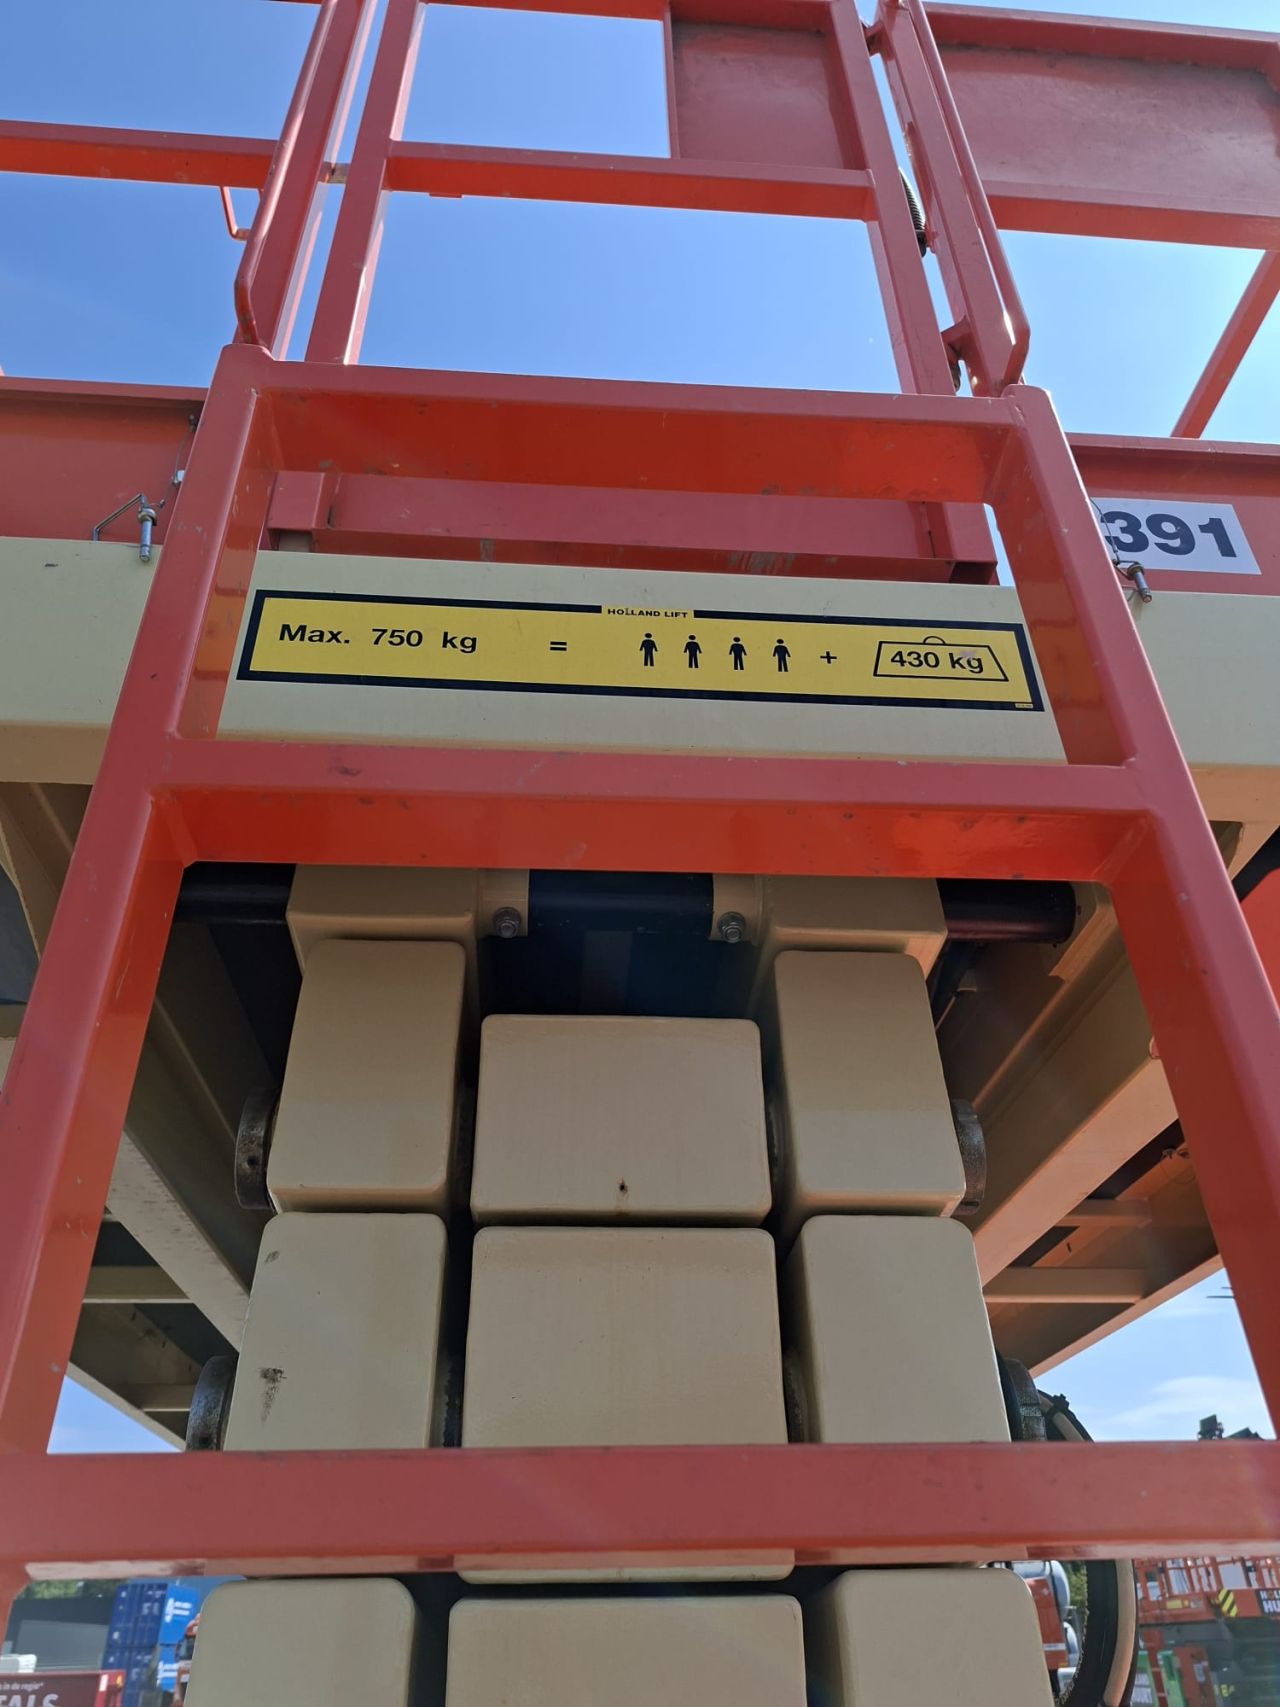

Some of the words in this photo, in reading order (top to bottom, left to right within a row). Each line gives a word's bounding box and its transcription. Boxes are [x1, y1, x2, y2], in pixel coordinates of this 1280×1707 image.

[1100, 510, 1237, 558] 391
[607, 608, 661, 618] HOLLAND
[664, 611, 689, 619] LIFT
[279, 623, 350, 644] Max.
[371, 628, 423, 647] 750
[442, 631, 478, 654] kg
[890, 650, 941, 668] 430
[948, 652, 984, 674] kg
